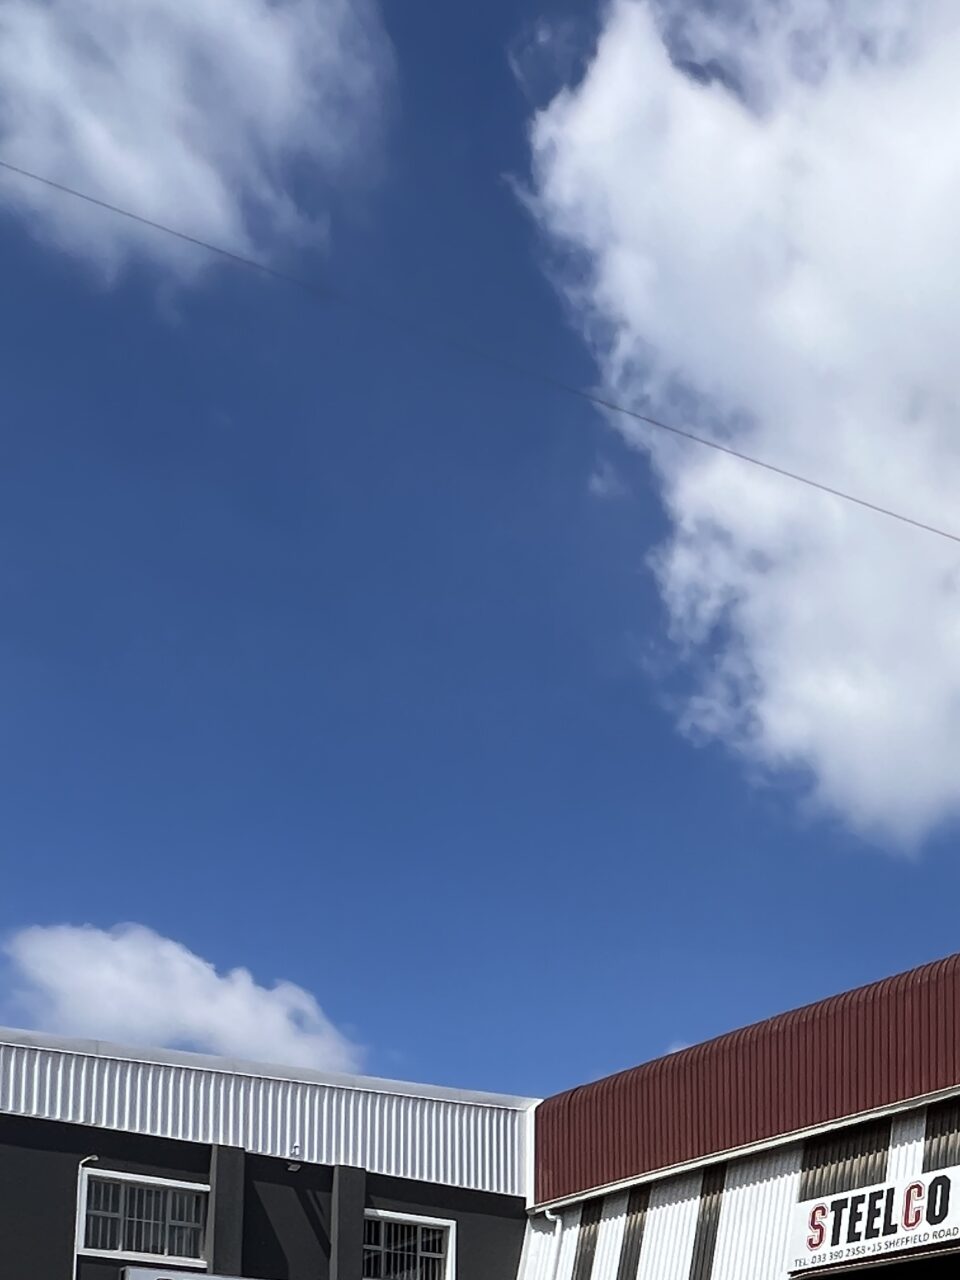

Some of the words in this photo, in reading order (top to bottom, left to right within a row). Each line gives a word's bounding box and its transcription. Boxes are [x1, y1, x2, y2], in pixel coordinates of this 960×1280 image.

[806, 1175, 951, 1251] STEELCO
[811, 1254, 827, 1265] 033
[829, 1251, 844, 1262] 390
[884, 1233, 930, 1251] SHEFFIELD
[932, 1227, 960, 1240] ROAD
